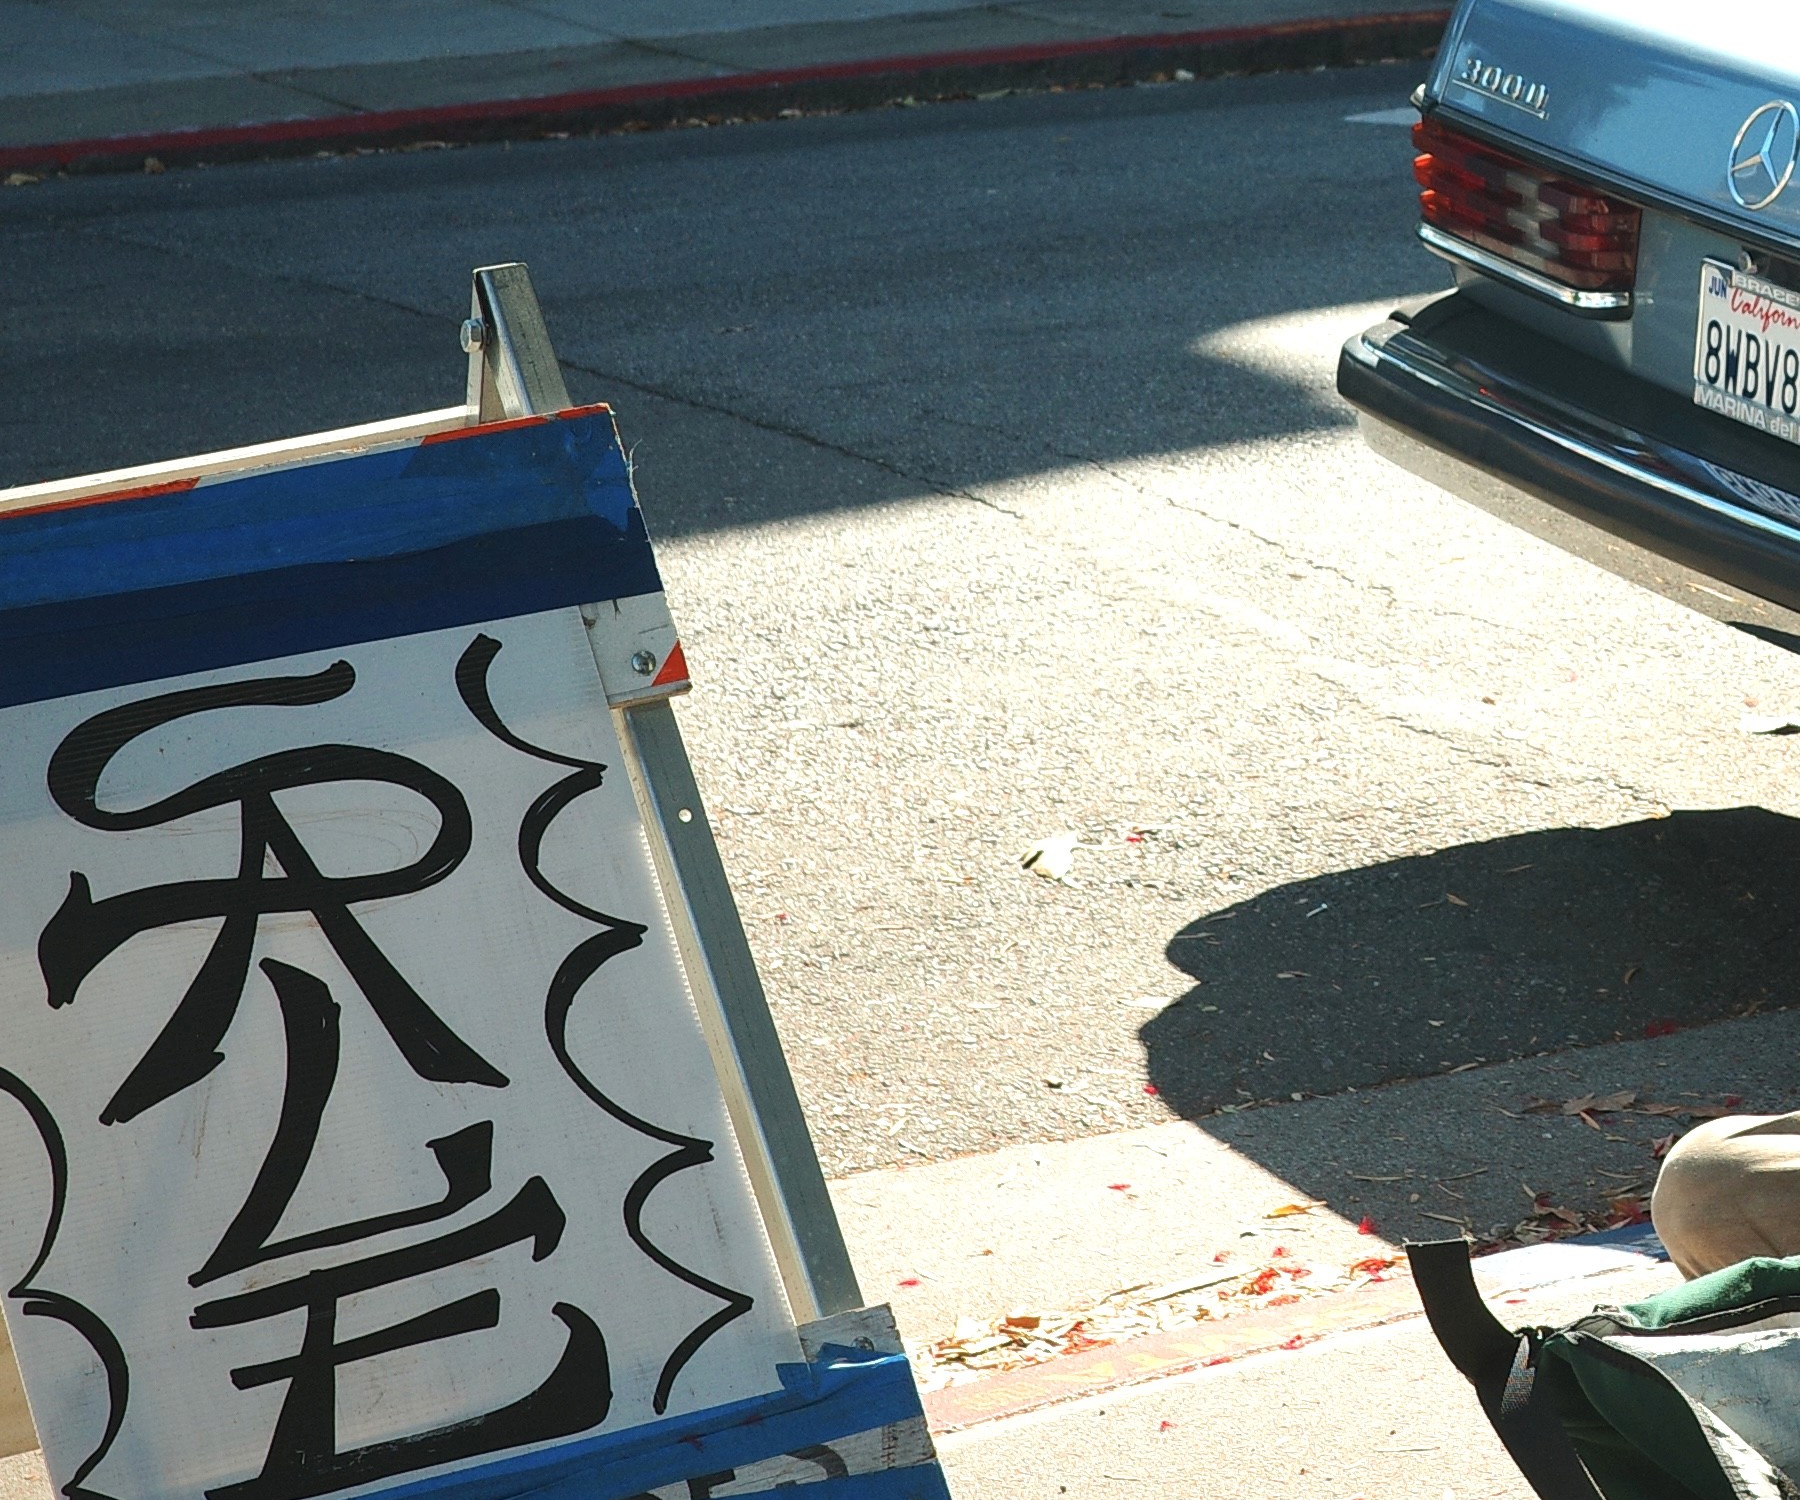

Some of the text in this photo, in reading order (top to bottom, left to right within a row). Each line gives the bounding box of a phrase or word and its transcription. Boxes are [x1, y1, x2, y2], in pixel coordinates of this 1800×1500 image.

[1708, 276, 1728, 299] JUN
[1699, 386, 1767, 430] MARINA
[1770, 416, 1795, 438] del
